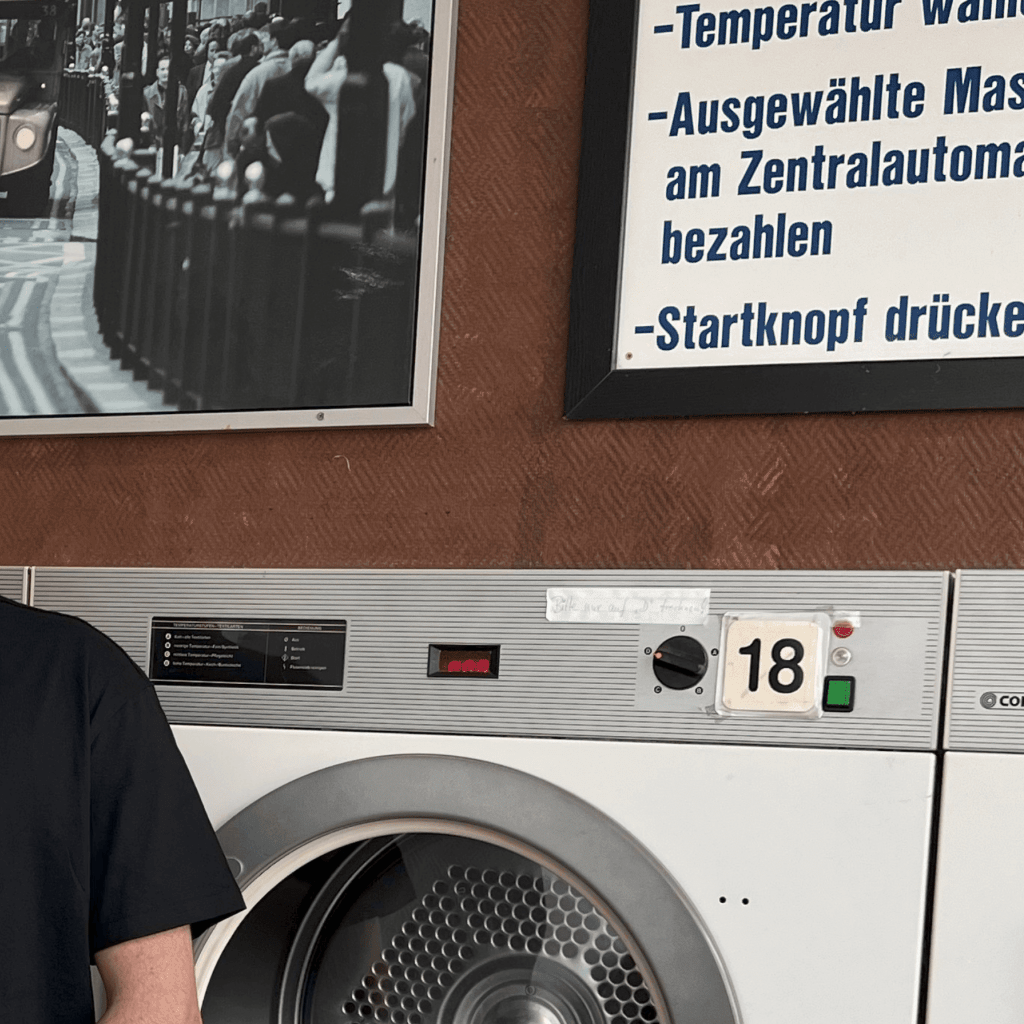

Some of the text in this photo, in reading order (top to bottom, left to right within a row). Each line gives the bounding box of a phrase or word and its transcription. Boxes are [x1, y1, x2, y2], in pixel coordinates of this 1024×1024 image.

[944, 66, 1024, 114] Mas
[666, 164, 720, 200] am
[662, 213, 832, 264] bezahlen
[885, 292, 1024, 341] drücke
[739, 638, 804, 694] 18
[999, 695, 1024, 707] CO
